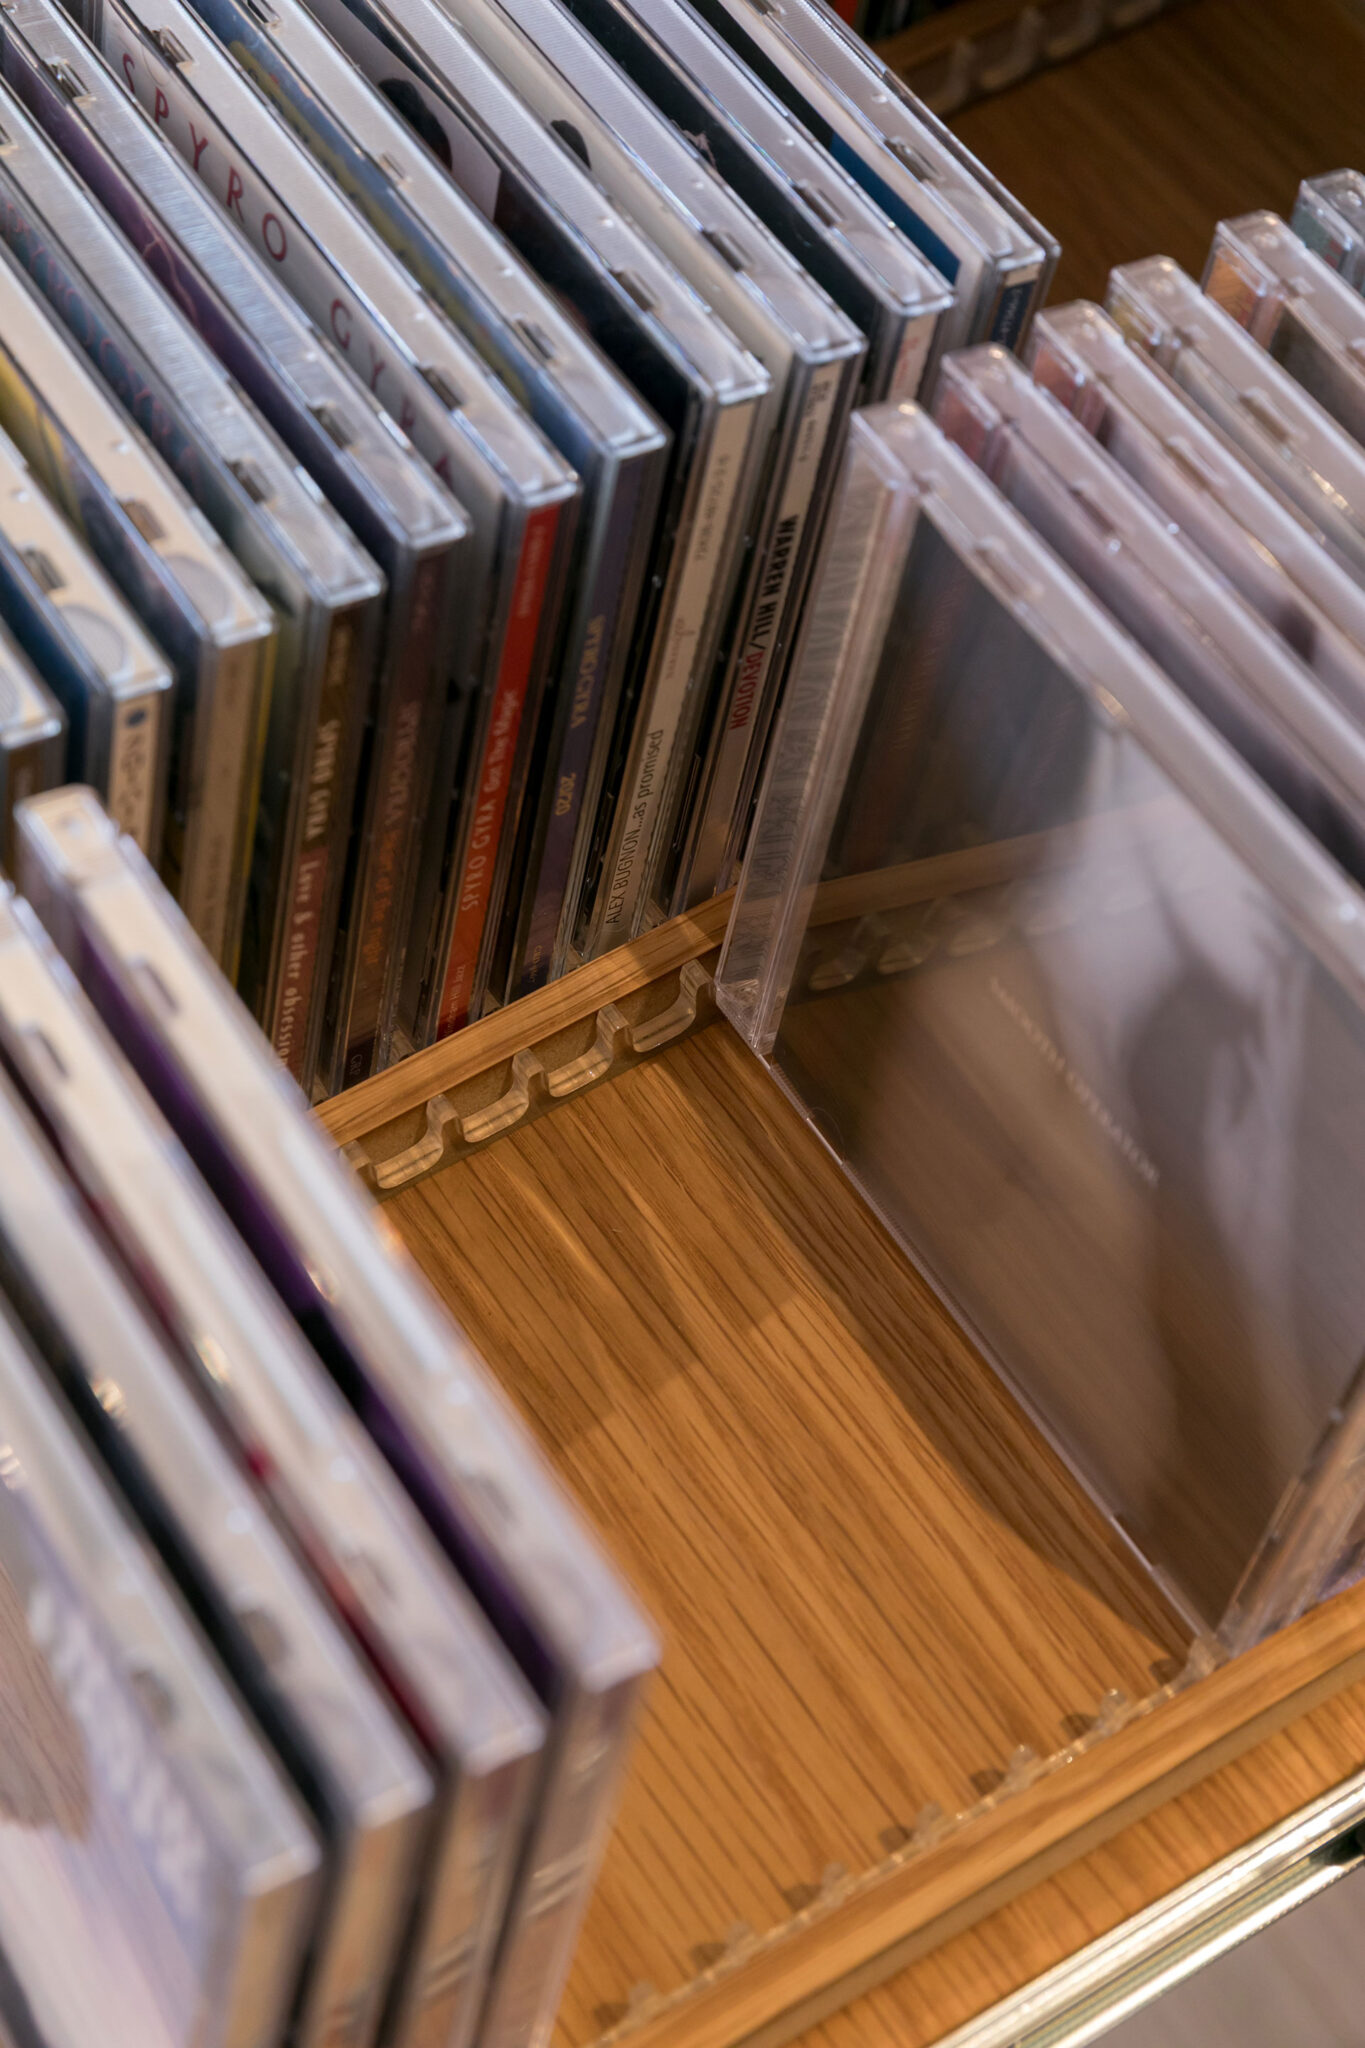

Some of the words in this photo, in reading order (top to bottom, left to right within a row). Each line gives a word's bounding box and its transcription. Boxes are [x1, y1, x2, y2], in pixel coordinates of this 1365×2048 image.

[122, 53, 288, 263] SPYRO
[762, 513, 799, 597] WARREN
[554, 772, 577, 816] 20/20
[472, 799, 497, 850] GYRA
[605, 891, 627, 925] ALEX
[638, 728, 664, 797] promised
[296, 860, 321, 903] Love
[461, 855, 486, 911] SPYRO
[293, 912, 315, 925] &
[287, 932, 309, 979] other
